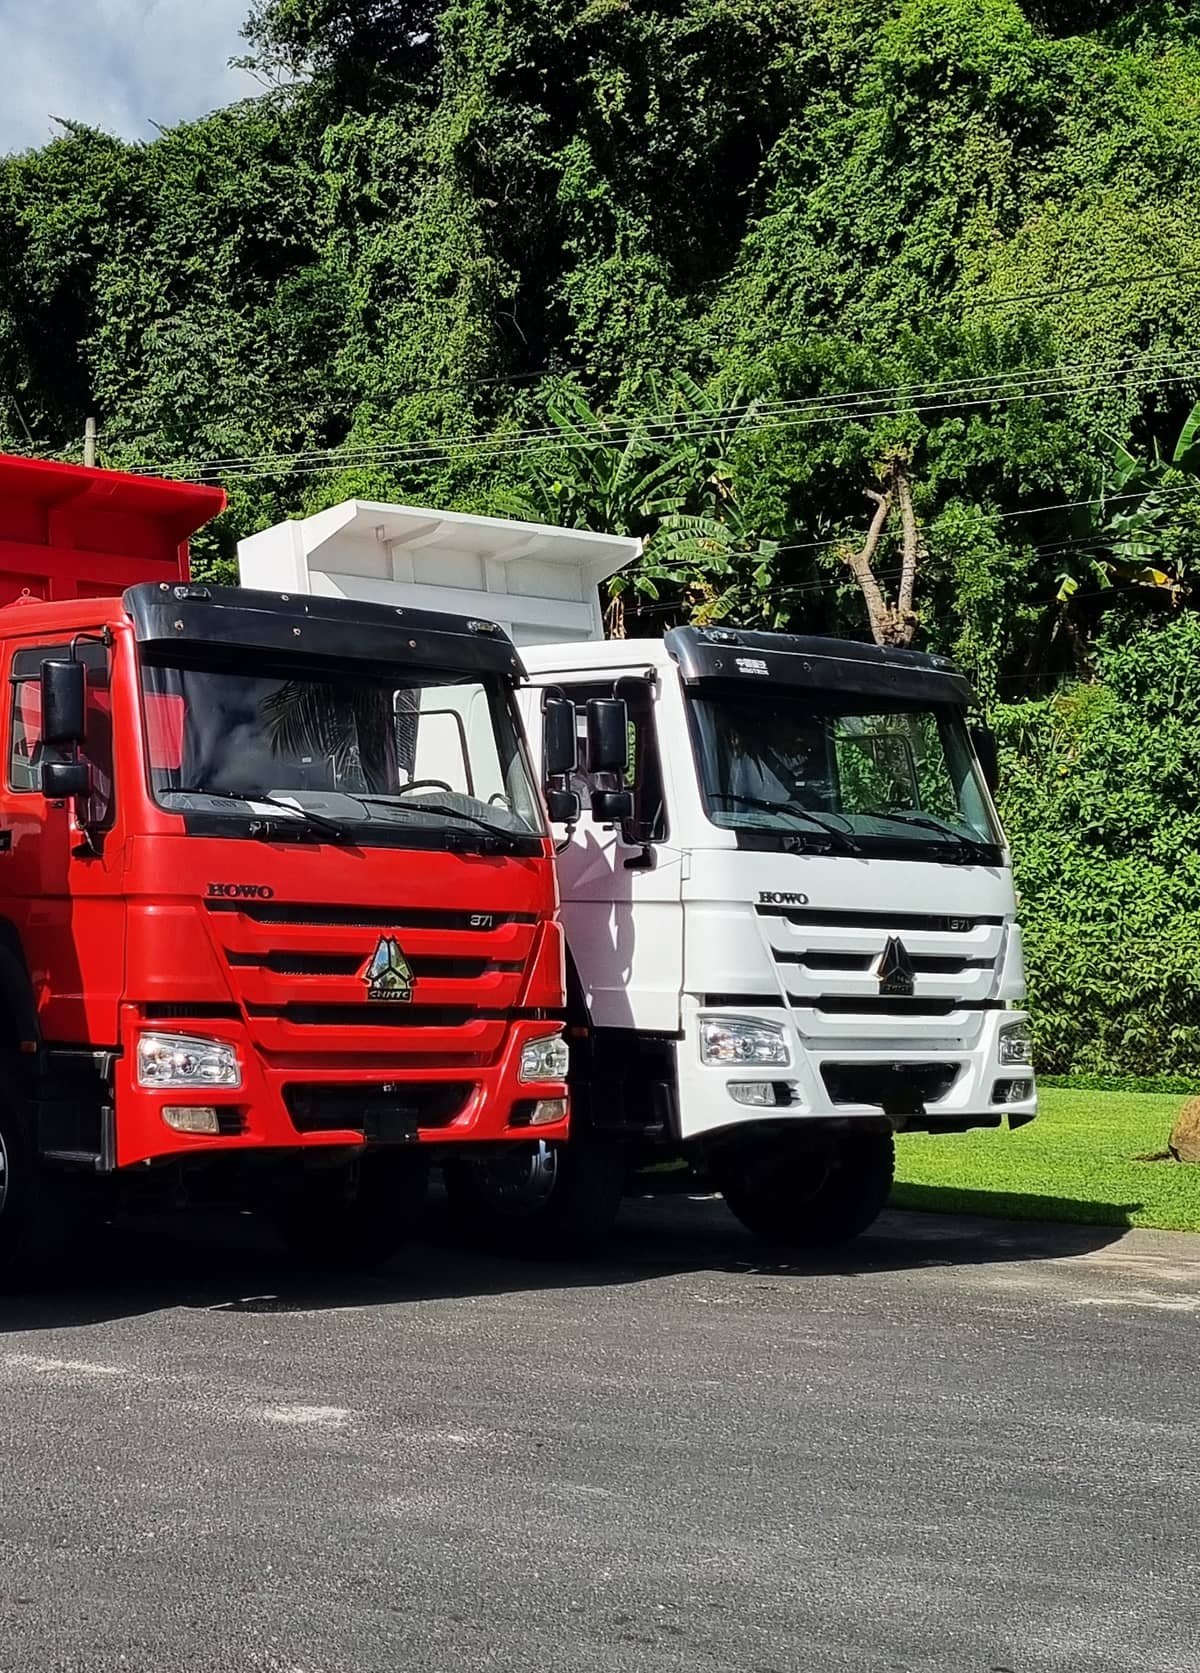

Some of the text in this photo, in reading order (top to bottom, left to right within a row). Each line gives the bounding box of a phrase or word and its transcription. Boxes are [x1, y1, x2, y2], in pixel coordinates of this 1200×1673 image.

[207, 883, 274, 899] HOWO
[758, 891, 809, 905] HOWO
[470, 914, 493, 927] 371
